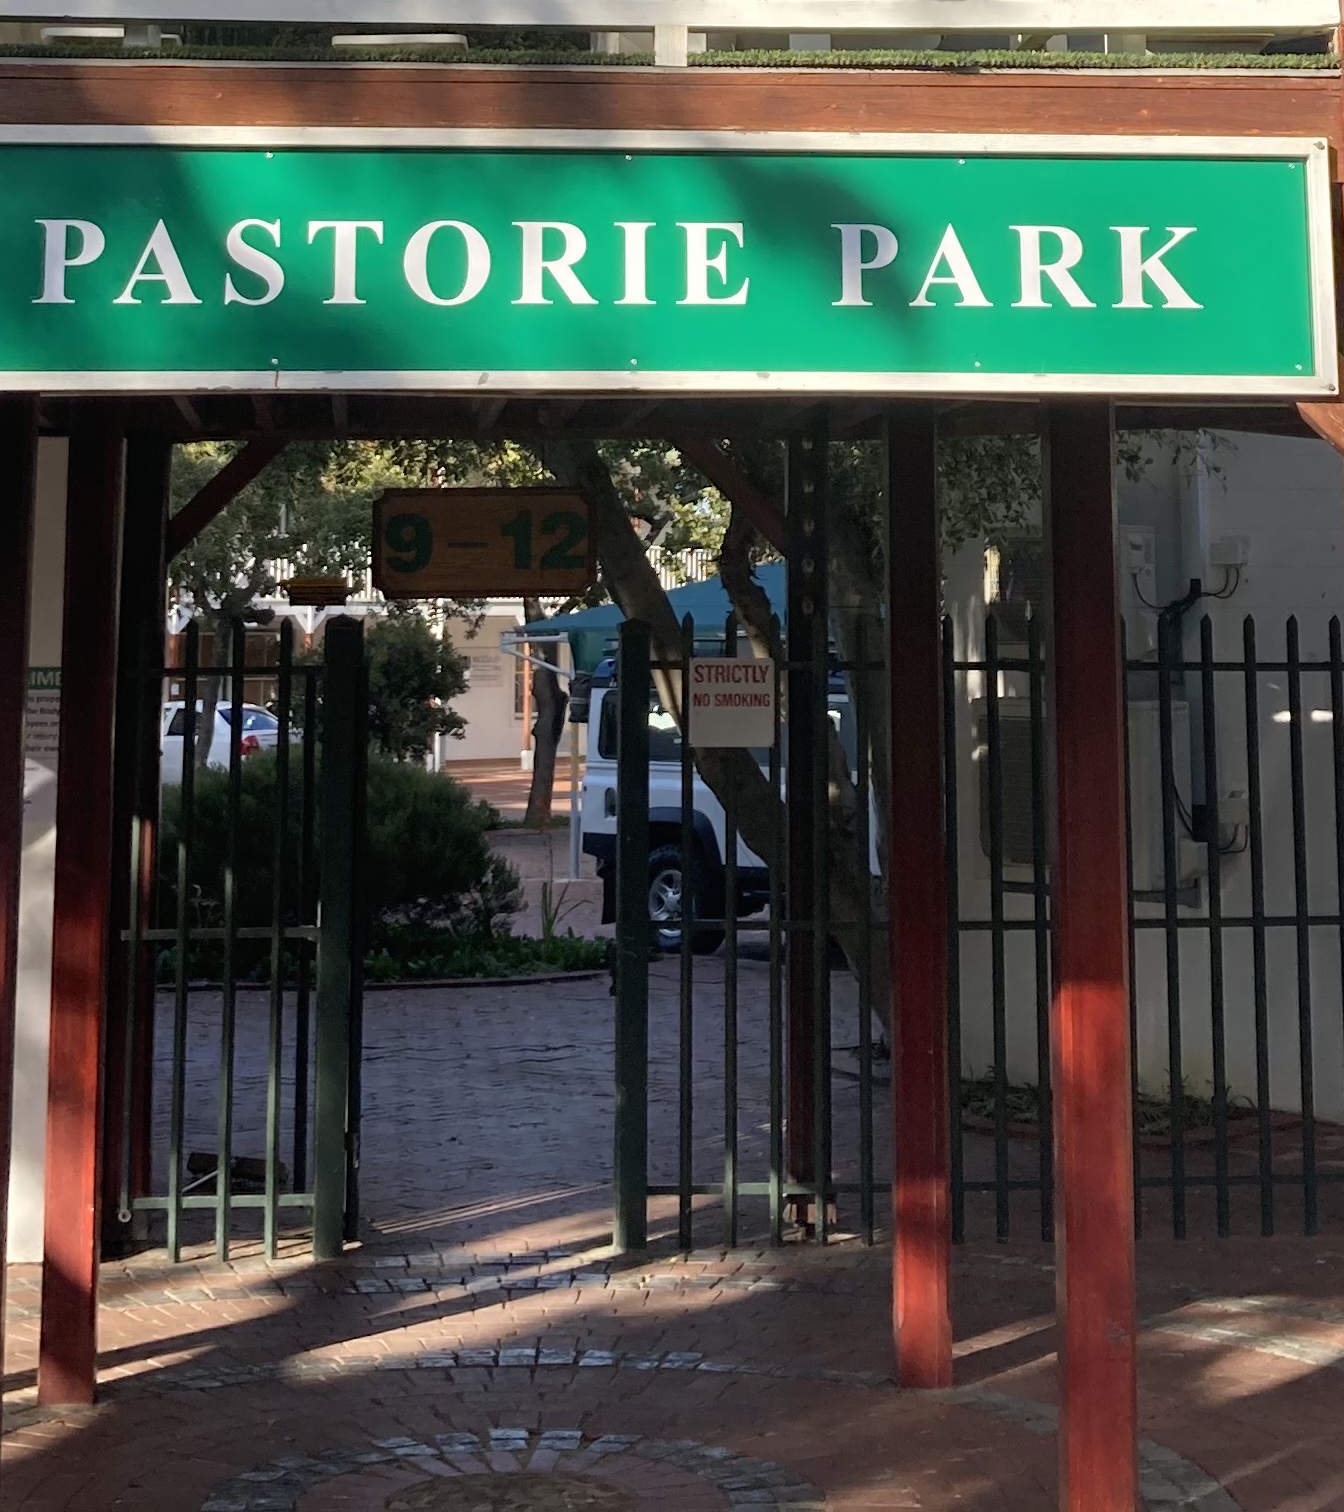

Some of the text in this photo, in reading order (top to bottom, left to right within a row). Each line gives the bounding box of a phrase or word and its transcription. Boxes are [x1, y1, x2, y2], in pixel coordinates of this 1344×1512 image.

[31, 218, 1203, 309] PASTORIE PARK
[694, 664, 770, 683] STRICTLY
[693, 693, 771, 707] NO SMOKING
